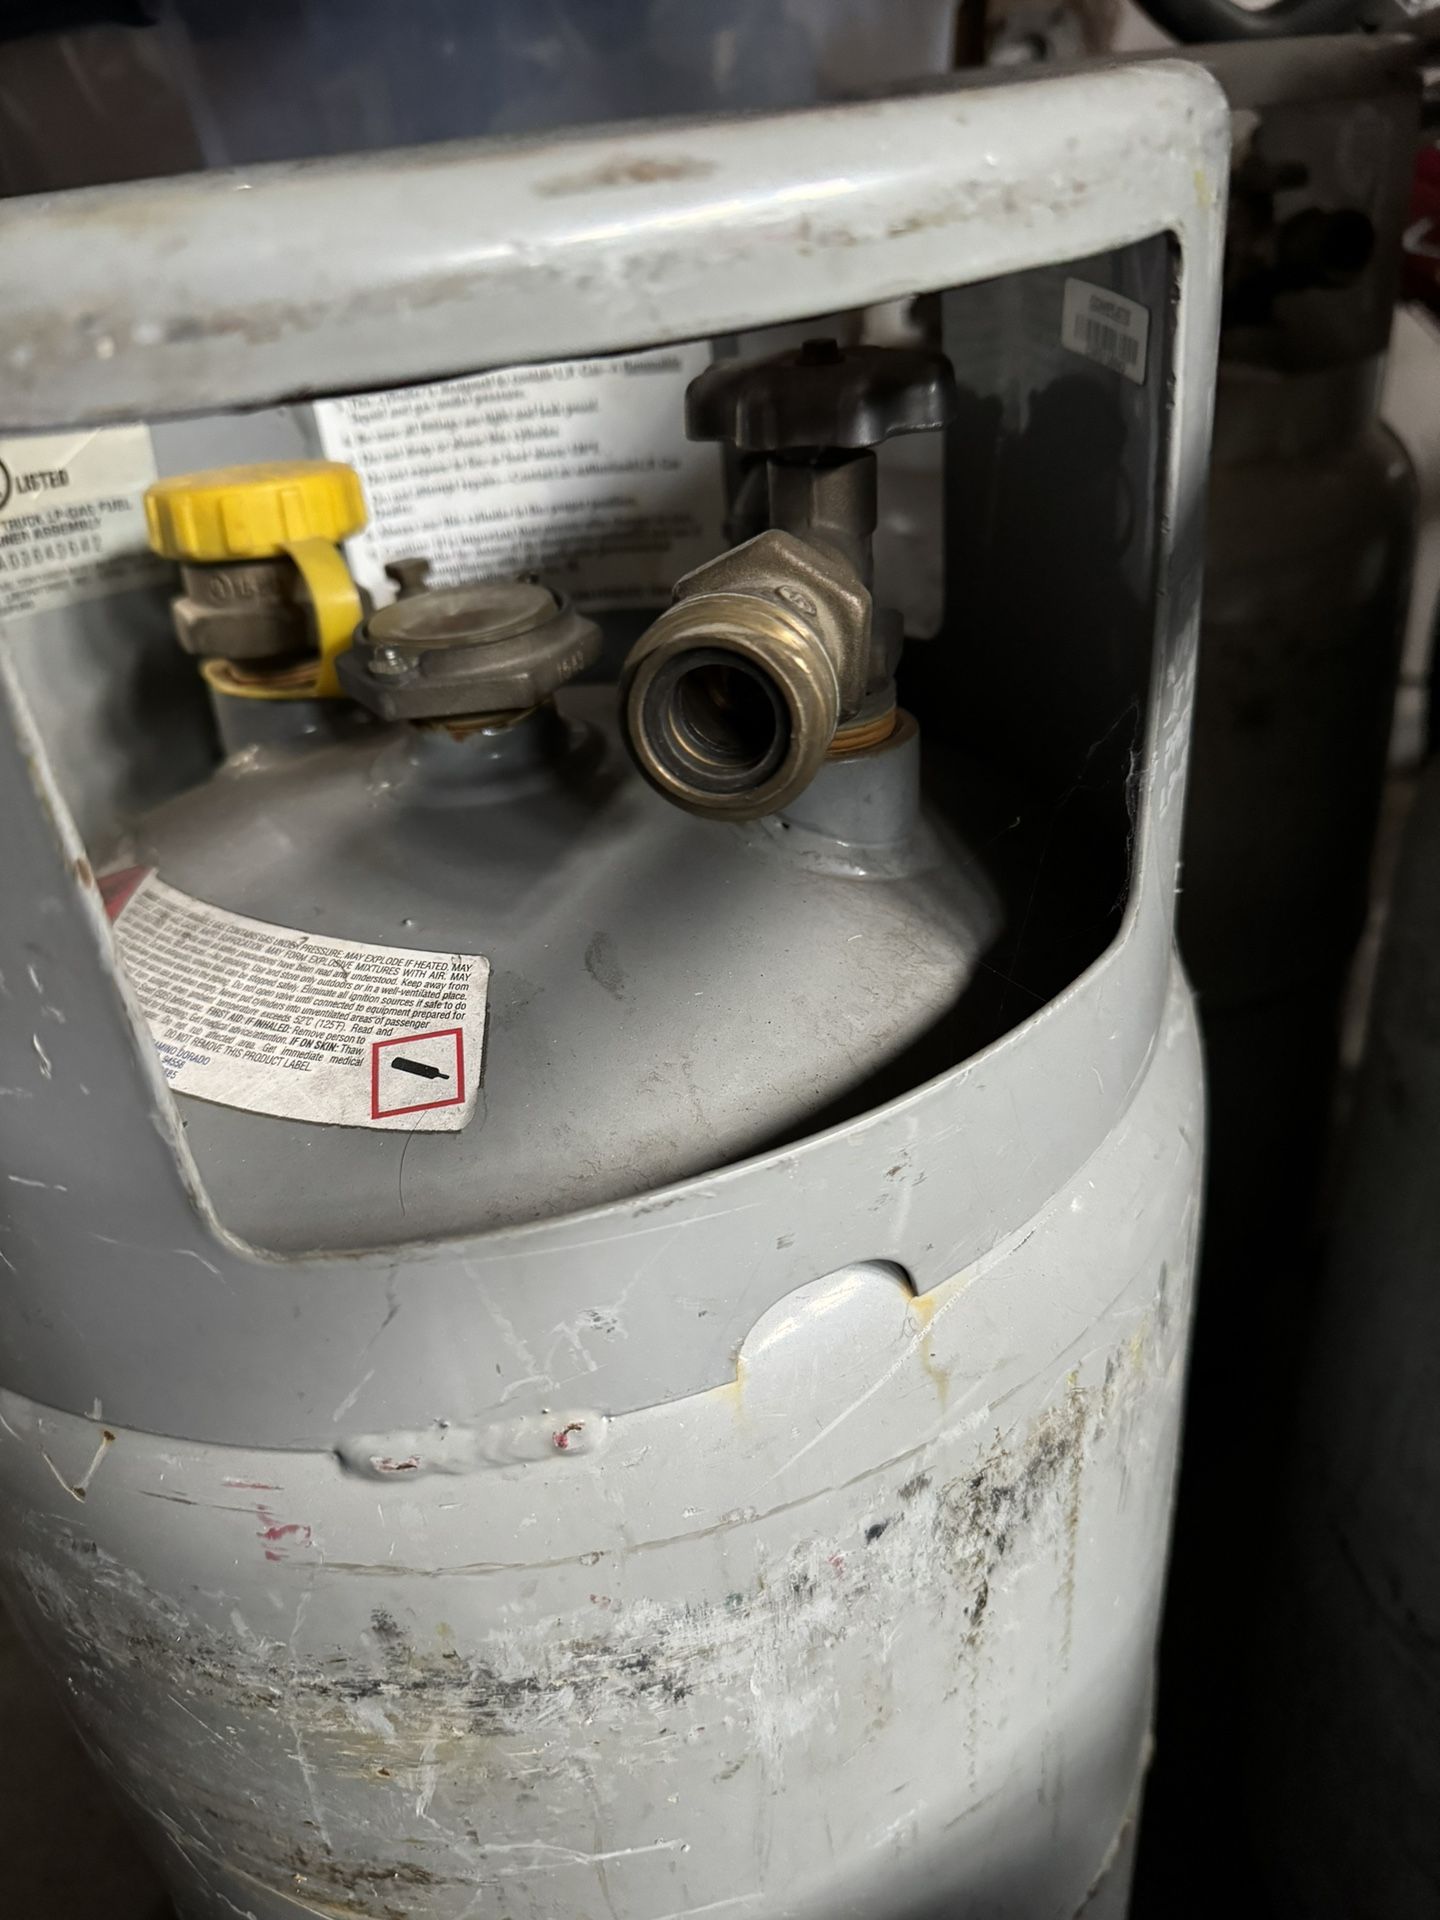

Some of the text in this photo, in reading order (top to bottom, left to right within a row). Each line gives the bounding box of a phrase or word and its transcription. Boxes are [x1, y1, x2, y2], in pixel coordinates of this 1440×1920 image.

[15, 468, 70, 495] LISTED
[264, 946, 286, 956] MAY
[285, 950, 308, 962] FORM
[308, 954, 354, 970] EXPLOSIVE
[354, 962, 400, 975] MIXTURES
[402, 968, 427, 979] WITH
[428, 971, 447, 980] AIR.
[450, 973, 472, 982] MAY
[344, 952, 364, 961] MAY
[364, 954, 404, 967] EXPLODE
[415, 960, 450, 972] HEATED.
[451, 963, 473, 972] MAY
[280, 970, 301, 982] store
[317, 979, 353, 990] outdoors
[364, 983, 373, 992] in
[382, 985, 441, 999] well-ventilated
[442, 992, 468, 1001] place.
[315, 968, 332, 977] read
[351, 972, 398, 986] understood.
[401, 979, 423, 990] Keep
[424, 982, 447, 991] away
[448, 982, 470, 991] from
[301, 984, 338, 998] Eliminate
[337, 991, 348, 999] all
[348, 992, 380, 1004] ignition
[381, 996, 415, 1007] sources
[416, 998, 423, 1007] if
[424, 1000, 442, 1010] safe
[443, 1001, 454, 1010] to
[454, 1002, 467, 1010] do
[313, 998, 354, 1010] connected
[355, 1003, 365, 1012] to
[366, 1005, 413, 1018] equipment
[412, 1010, 452, 1021] prepared
[452, 1012, 466, 1020] for
[206, 1006, 230, 1019] FIRST
[244, 1016, 256, 1026] IF
[254, 1018, 292, 1034] INHALED:
[292, 1026, 326, 1040] Remove
[325, 1032, 356, 1044] person
[356, 1036, 366, 1045] to
[260, 1010, 292, 1022] exceeds
[350, 1024, 374, 1034] Read
[376, 1027, 394, 1036] and
[285, 1004, 301, 1014] into
[301, 1006, 350, 1021] unventilated
[350, 1014, 374, 1024] areas
[374, 1016, 384, 1025] of
[384, 1018, 430, 1030] passenger
[164, 1028, 178, 1039] DO
[176, 1031, 194, 1044] NOT
[192, 1036, 225, 1053] REMOVE
[224, 1045, 244, 1058] THIS
[242, 1050, 286, 1066] PRODUCT
[176, 1046, 211, 1066] DORADO
[262, 1042, 278, 1054] Get
[281, 1046, 325, 1062] immediate
[330, 1055, 365, 1067] medical
[288, 1036, 301, 1046] IF
[300, 1038, 314, 1048] ON
[314, 1040, 340, 1053] SKIN:
[340, 1044, 365, 1056] Thaw
